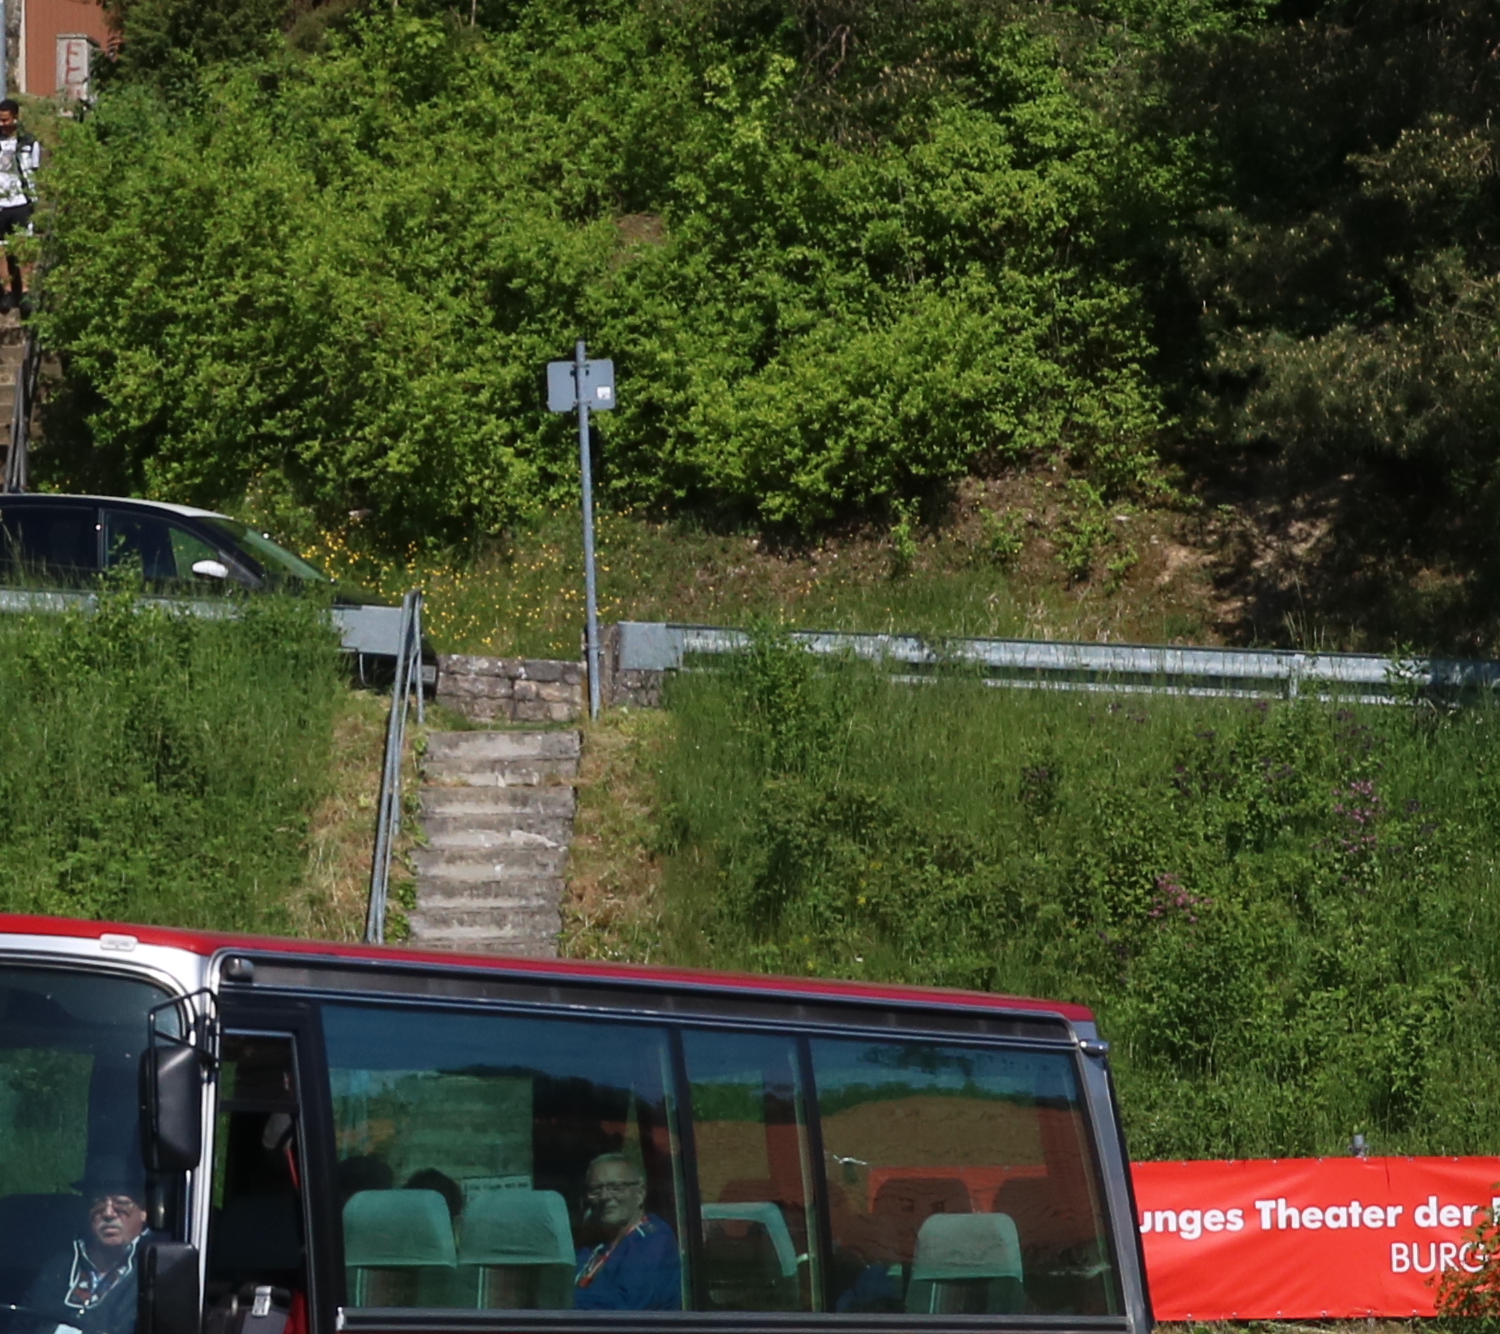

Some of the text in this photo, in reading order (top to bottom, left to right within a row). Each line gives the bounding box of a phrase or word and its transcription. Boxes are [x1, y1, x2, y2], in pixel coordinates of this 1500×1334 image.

[1254, 1197, 1404, 1230] Theater
[1413, 1195, 1479, 1228] der
[1390, 1241, 1485, 1273] BURG
